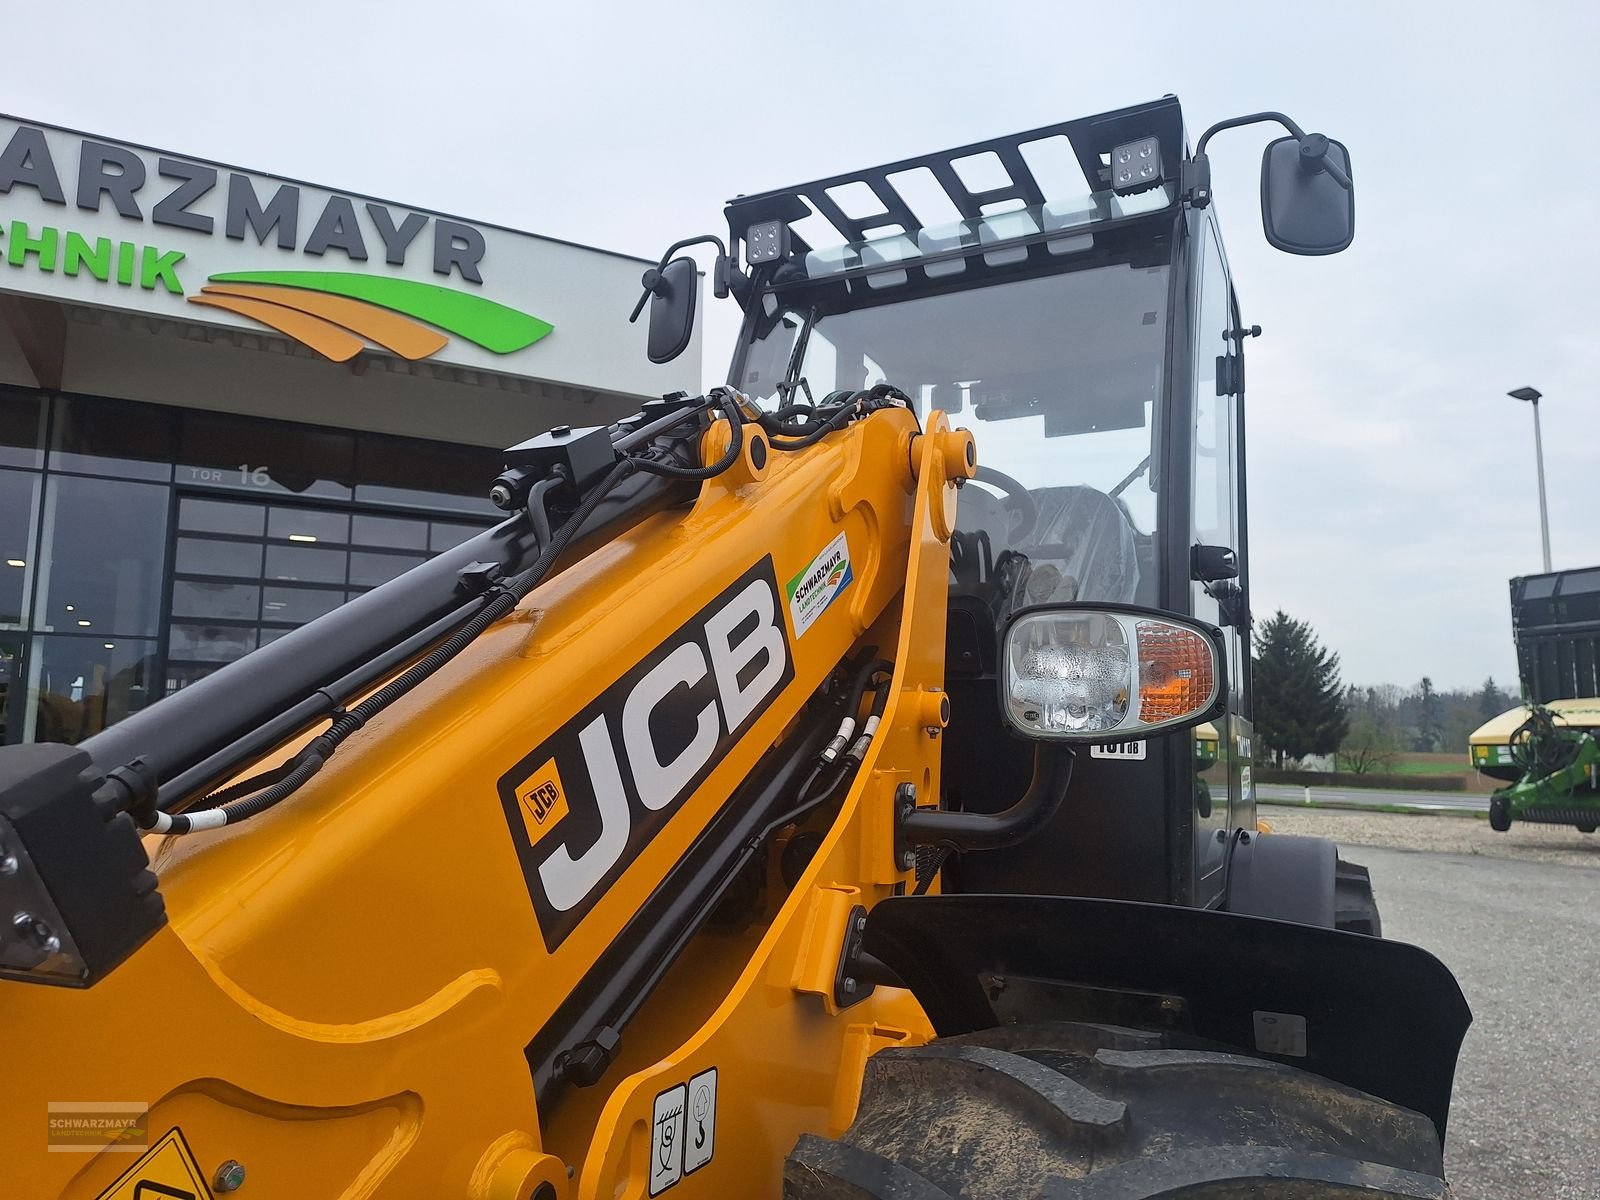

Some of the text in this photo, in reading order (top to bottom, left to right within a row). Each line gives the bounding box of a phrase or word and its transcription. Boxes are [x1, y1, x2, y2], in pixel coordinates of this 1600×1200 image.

[0, 219, 186, 294] HNIK
[190, 464, 271, 486] TOR 16
[795, 550, 841, 604] SCHWARZMAYR
[799, 581, 827, 613] LANDTECHNIK
[538, 579, 786, 912] JCB
[530, 783, 557, 820] JCB
